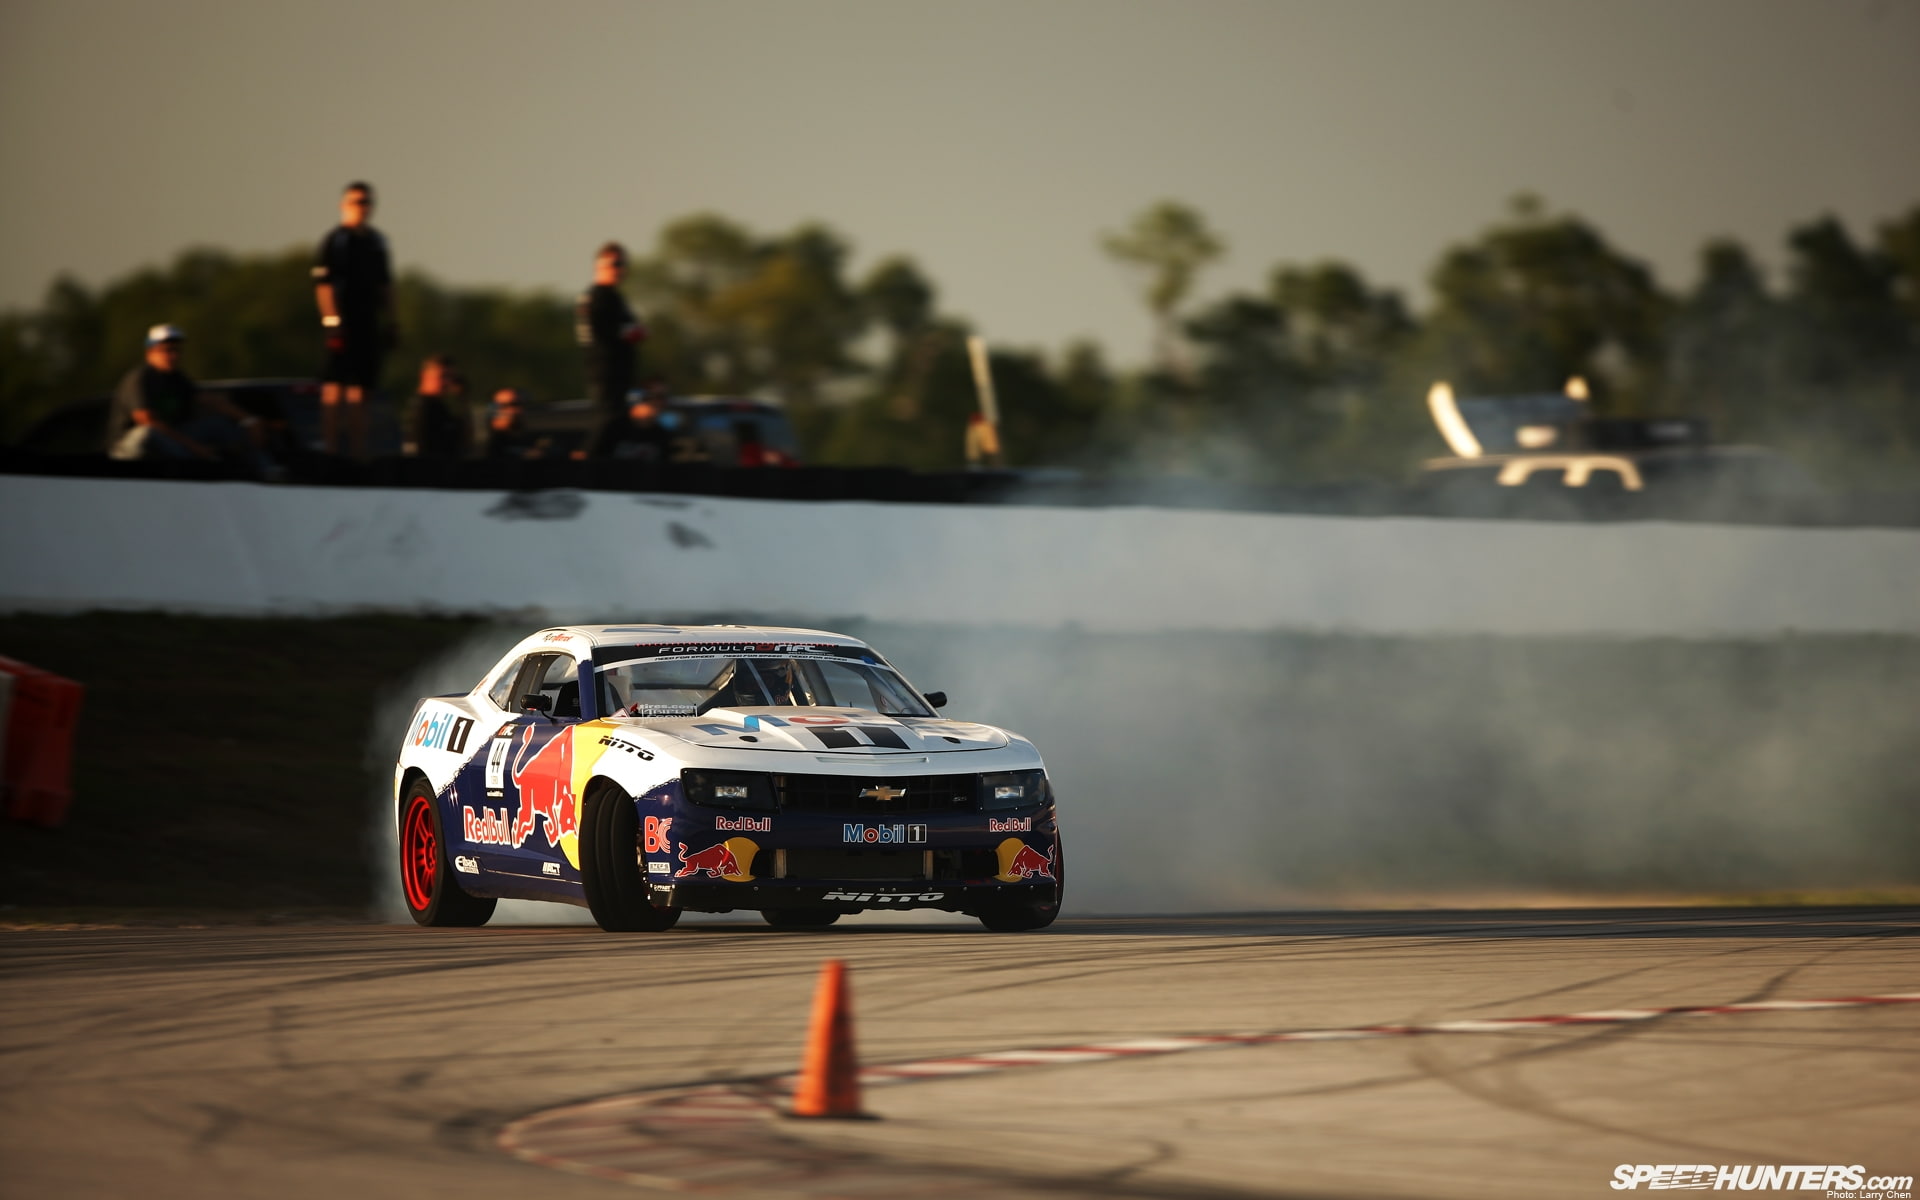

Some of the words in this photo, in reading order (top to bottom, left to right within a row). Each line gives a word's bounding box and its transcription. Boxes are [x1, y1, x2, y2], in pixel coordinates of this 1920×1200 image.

[659, 645, 755, 654] FORMULA
[406, 711, 454, 749] Mobil
[833, 726, 875, 746] 1
[598, 735, 656, 761] NITTO
[843, 823, 905, 843] Mobil
[822, 892, 944, 902] NITTO
